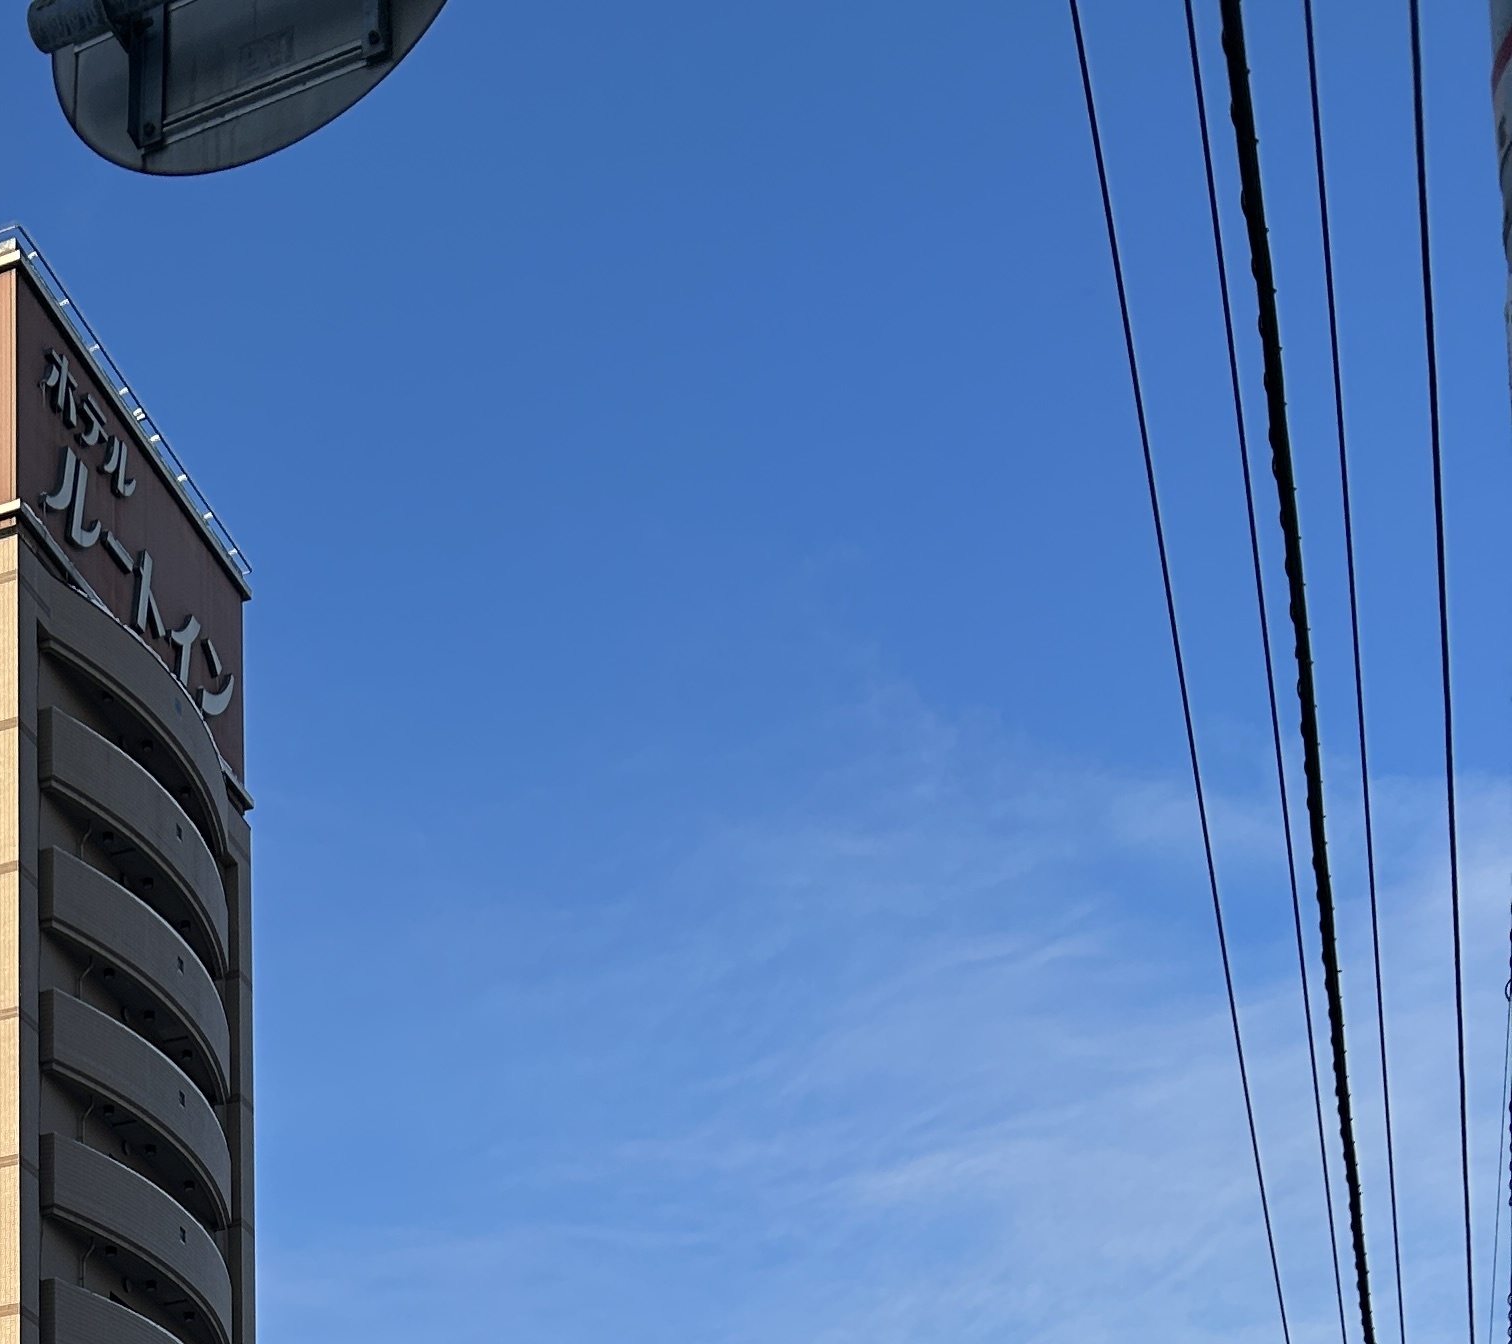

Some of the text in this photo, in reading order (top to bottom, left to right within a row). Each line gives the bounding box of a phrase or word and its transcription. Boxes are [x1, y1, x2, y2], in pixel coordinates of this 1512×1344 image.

[40, 348, 137, 498] ホテル
[40, 446, 236, 717] ルートイン
